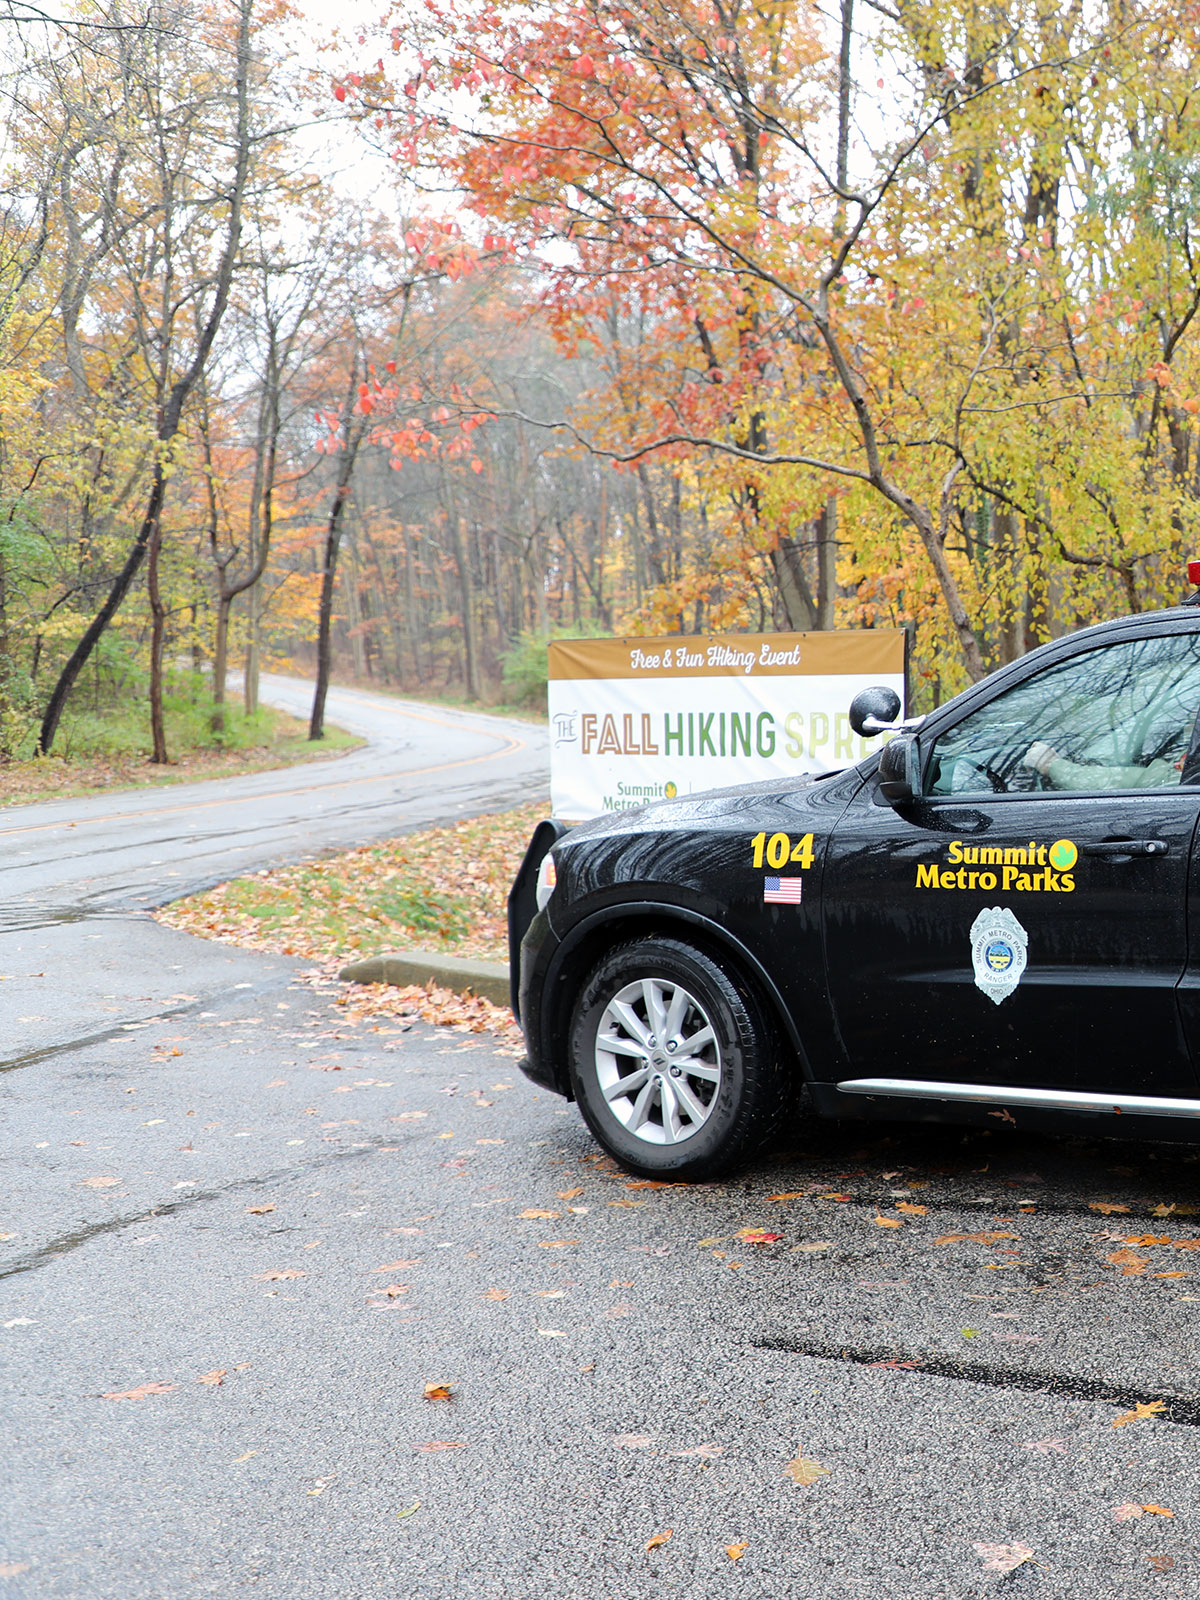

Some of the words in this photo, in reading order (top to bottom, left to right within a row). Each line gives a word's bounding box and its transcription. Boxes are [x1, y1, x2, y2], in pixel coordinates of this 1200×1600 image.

[630, 649, 661, 669] Free
[662, 649, 672, 668] &
[676, 647, 704, 667] Fun
[707, 645, 756, 674] Hiking
[759, 643, 801, 666] Event
[552, 710, 578, 748] THE
[581, 713, 659, 755] FALL
[664, 711, 776, 758] HIKING
[785, 711, 899, 760] SPR
[617, 782, 663, 797] Summit
[750, 832, 815, 870] 104
[948, 840, 1048, 866] Summit
[915, 864, 997, 890] Metro
[1002, 866, 1076, 892] Parks
[976, 935, 987, 964] SUMMIT
[988, 930, 1012, 940] METRO
[1012, 940, 1023, 966] PARKS
[984, 973, 1013, 983] RANGER
